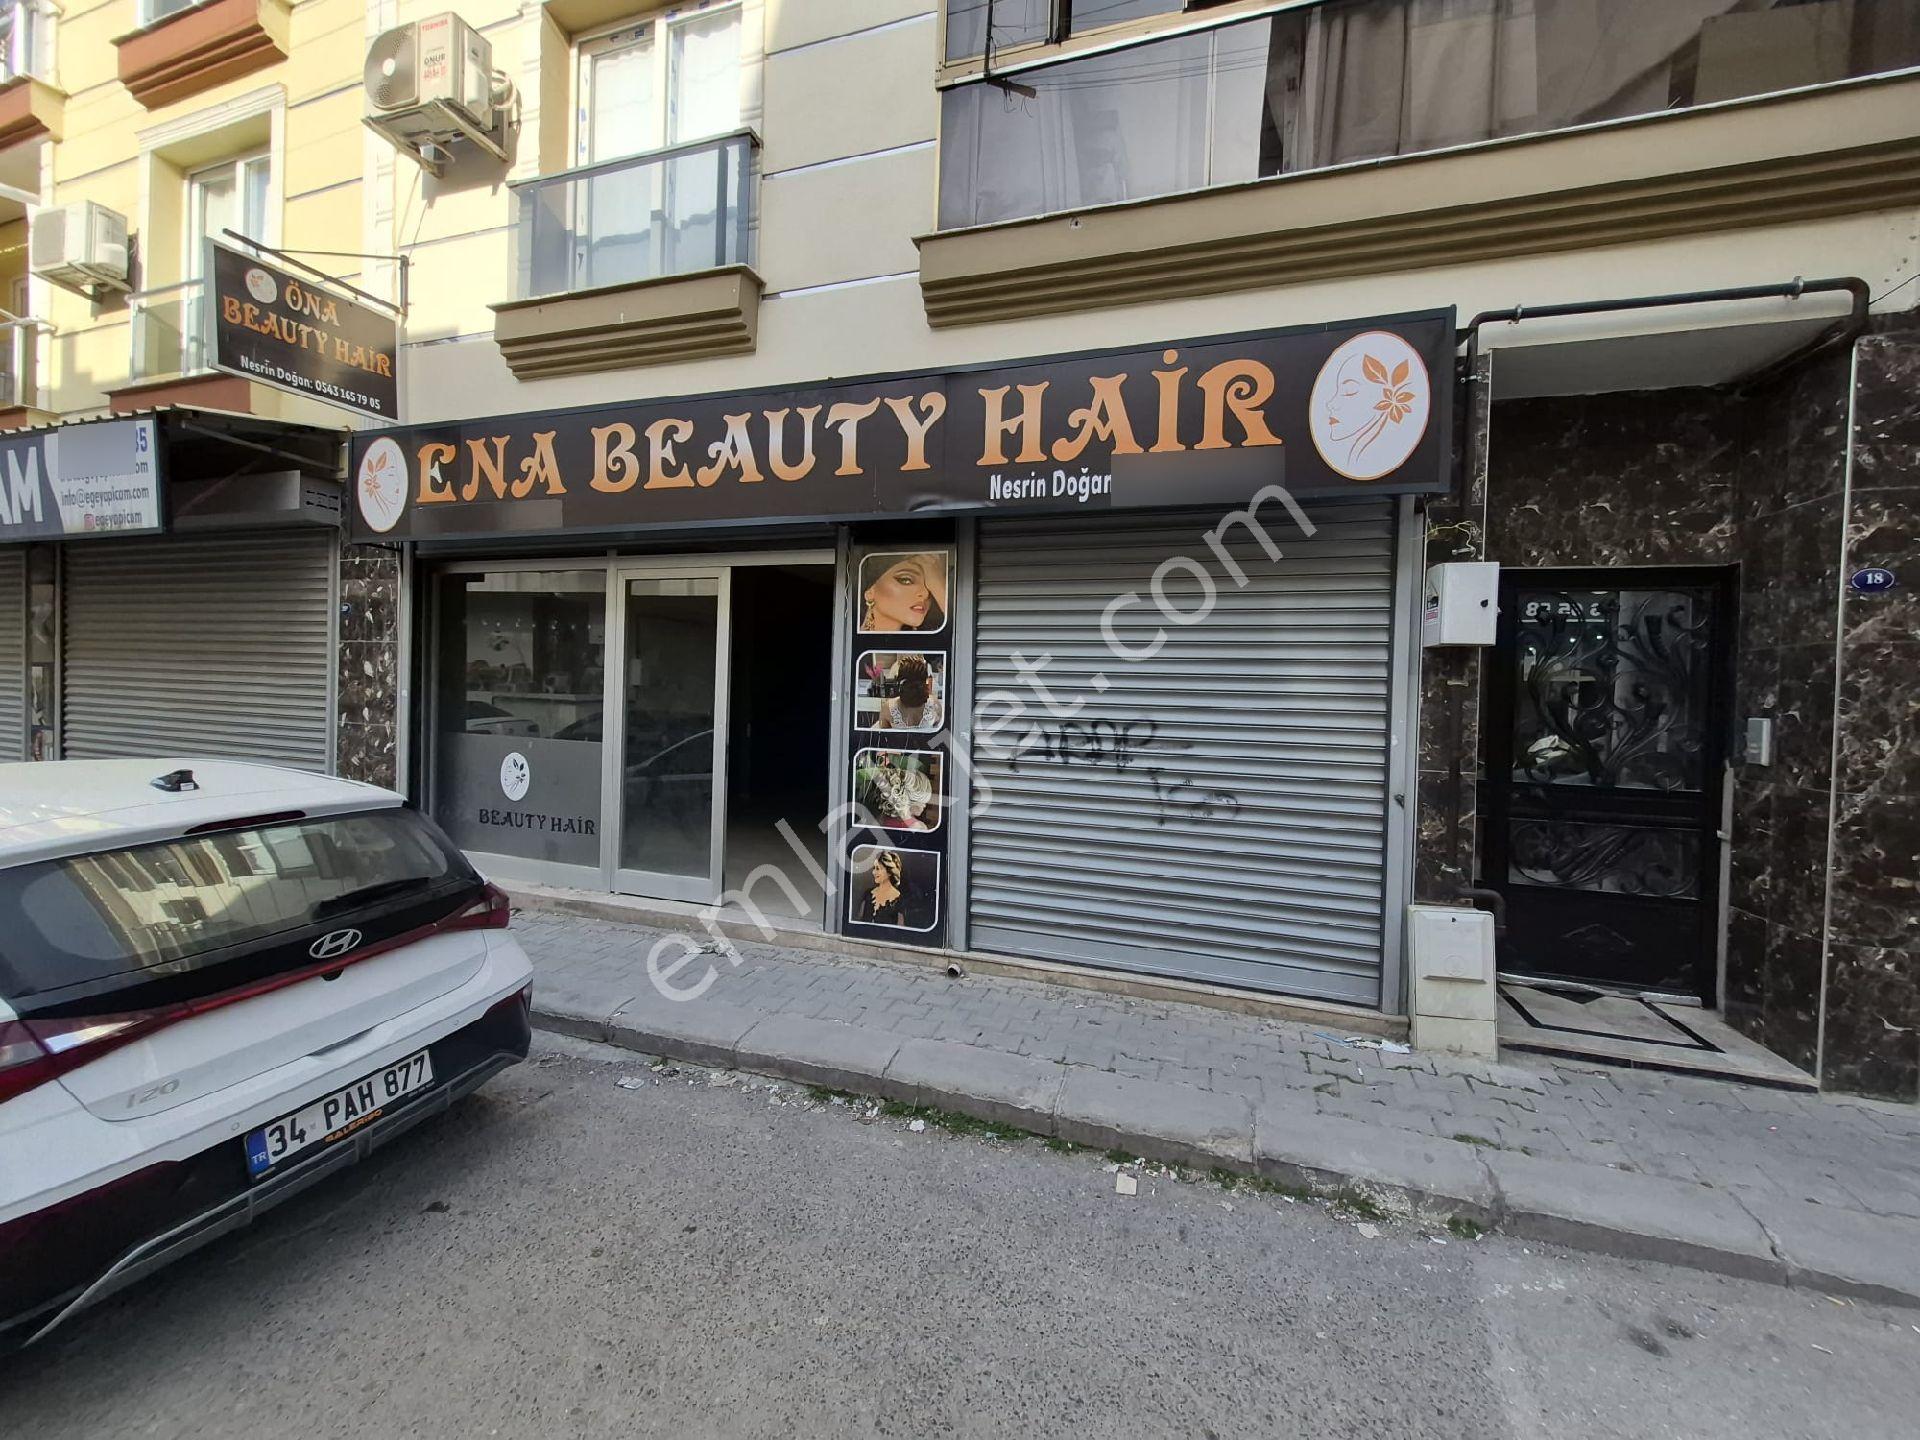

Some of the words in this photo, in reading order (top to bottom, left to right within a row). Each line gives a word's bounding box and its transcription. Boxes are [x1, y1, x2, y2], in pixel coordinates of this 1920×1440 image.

[223, 295, 329, 354] BEAUTY
[285, 279, 341, 327] ÖNA
[241, 355, 275, 377] Nesrin
[315, 379, 339, 397] 0543
[357, 393, 367, 405] 79
[369, 397, 381, 410] 05
[416, 430, 568, 503] ENA
[590, 391, 947, 493] BEAUTY
[976, 349, 1283, 467] HAİR
[990, 471, 1046, 500] Nesrin
[1866, 572, 1884, 585] 18
[479, 808, 547, 830] BEAUTY
[550, 815, 595, 835] HAİR
[268, 1117, 307, 1158] 34
[323, 1082, 375, 1131] PAH
[383, 1055, 425, 1097] 877
[251, 1151, 268, 1165] TR
